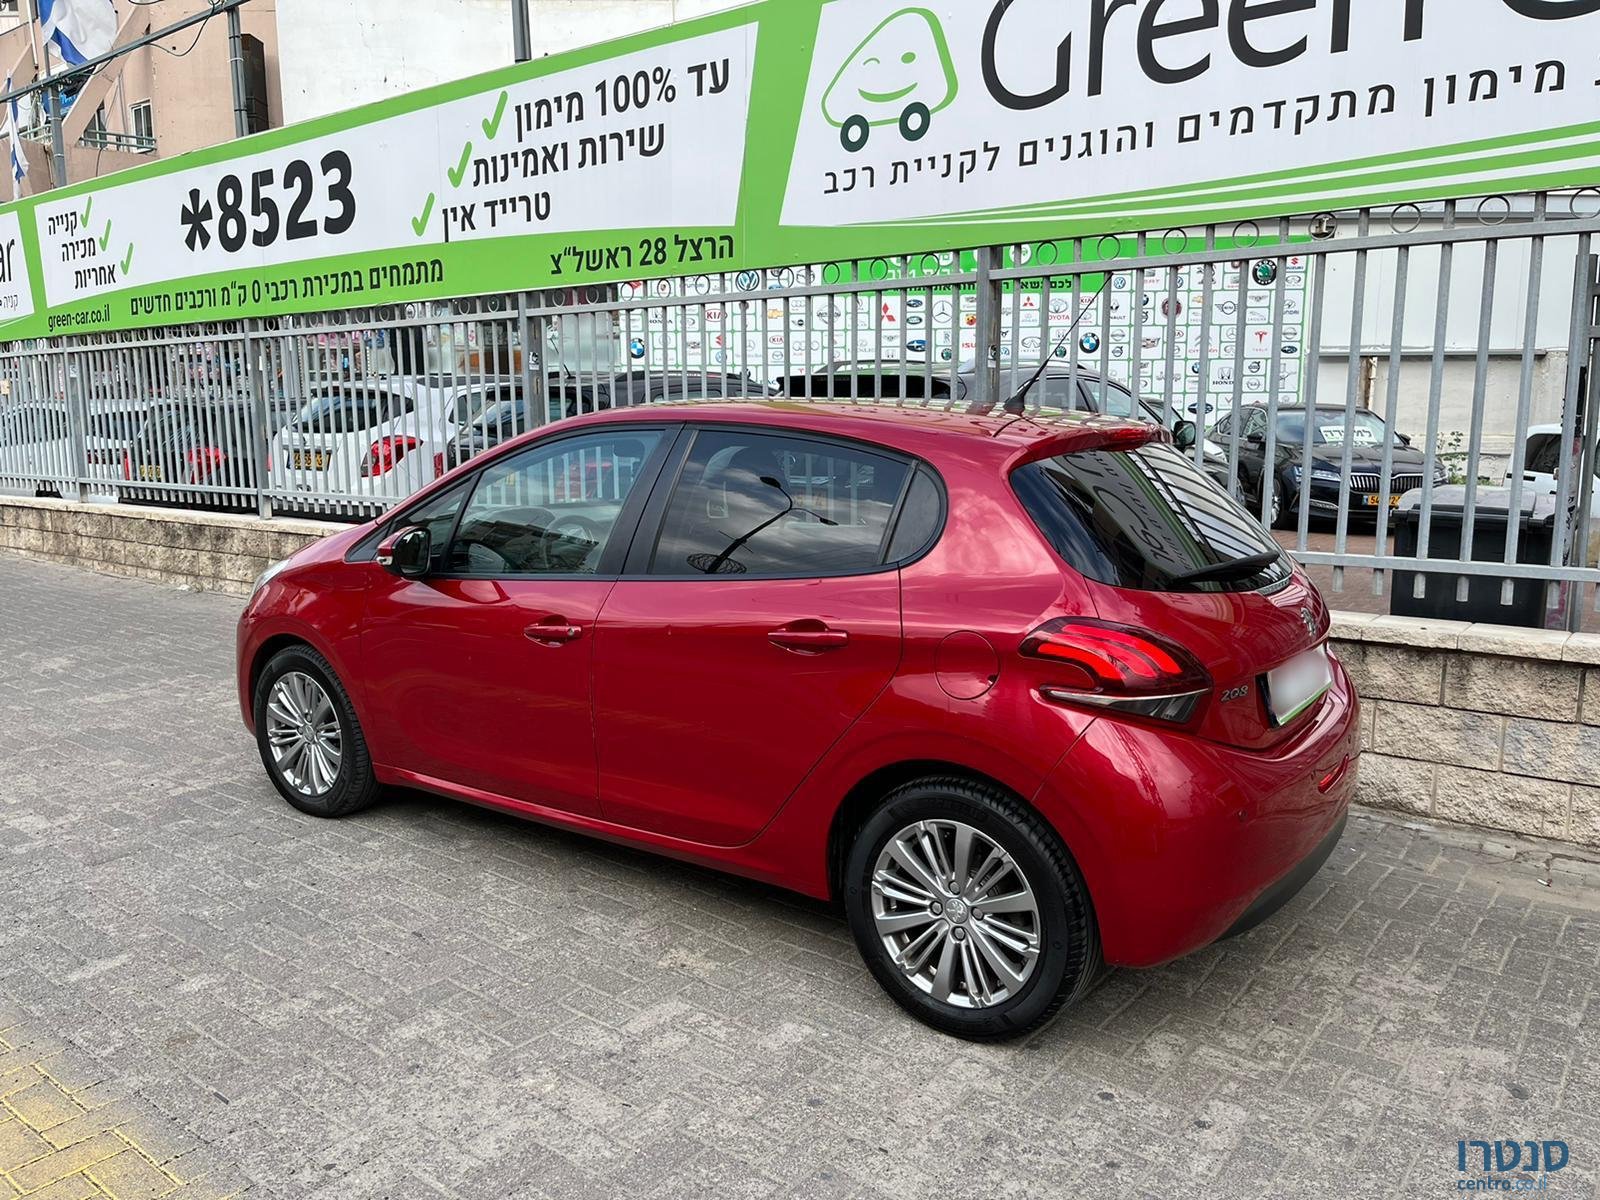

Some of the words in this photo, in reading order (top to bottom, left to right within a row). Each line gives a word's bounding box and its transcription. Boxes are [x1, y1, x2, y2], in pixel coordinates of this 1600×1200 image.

[595, 66, 677, 117] 100%
[687, 57, 730, 97] עד
[1424, 60, 1565, 117] מימון
[514, 91, 584, 143] מימון
[1178, 83, 1396, 144] מתקדמים
[578, 123, 665, 169] שירות
[1018, 121, 1154, 167] והוגנים
[472, 142, 569, 188] ואמינות
[889, 140, 1000, 183] לקניית
[823, 165, 875, 195] רכב
[48, 211, 78, 236] קנייה
[442, 203, 477, 243] אין
[484, 191, 551, 228] טרייד
[61, 237, 97, 262] מכירה
[639, 237, 667, 266] 28
[674, 234, 734, 263] הרצל
[74, 264, 117, 289] אחריות
[302, 271, 364, 298] במכירת
[369, 258, 444, 290] מתמחים
[130, 293, 171, 317] חדשים
[175, 287, 217, 312] ורכבים
[251, 279, 261, 304] 0
[265, 278, 298, 303] רכבי
[48, 304, 110, 332] green-car.co.il
[1220, 684, 1249, 702] 208
